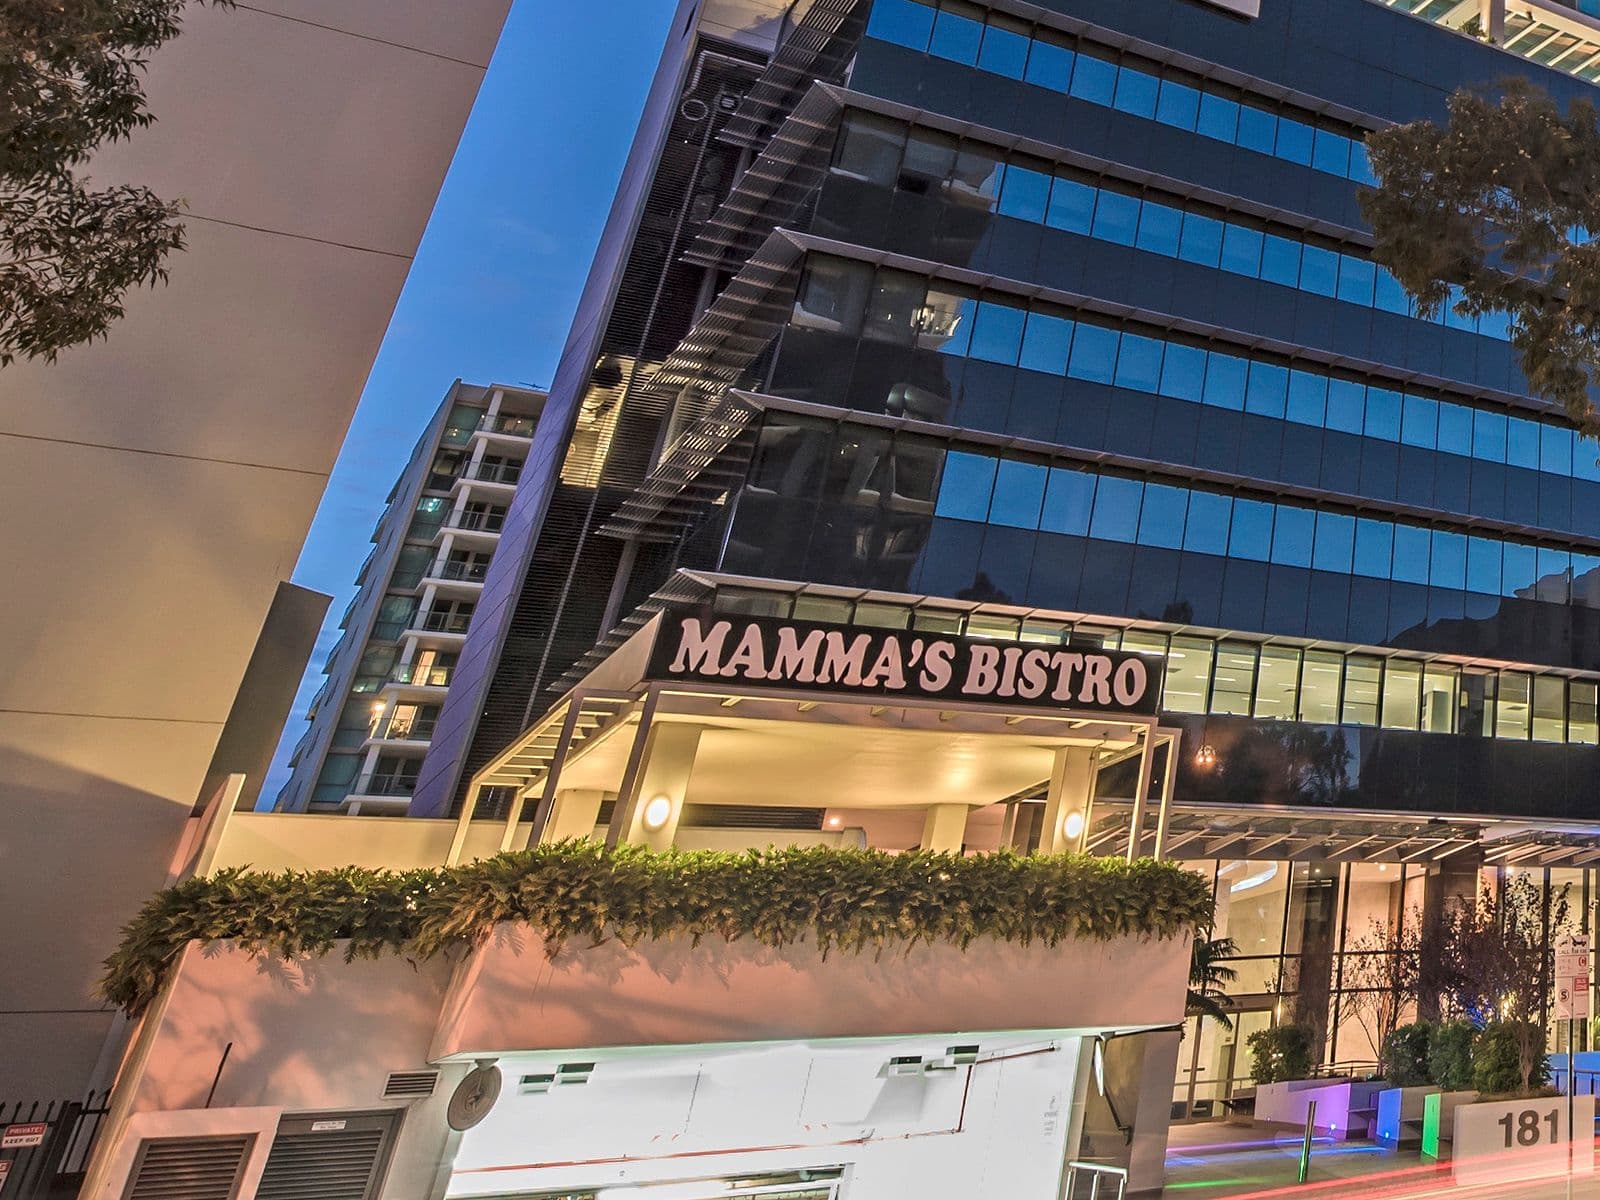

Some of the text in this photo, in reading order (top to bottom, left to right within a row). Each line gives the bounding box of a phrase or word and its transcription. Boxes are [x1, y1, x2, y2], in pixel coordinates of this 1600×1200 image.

[669, 619, 1147, 706] MAMMA'S BISTRO
[9, 1126, 43, 1135] PRIVATE!
[1498, 1109, 1559, 1148] 181
[4, 1137, 24, 1145] KEEP
